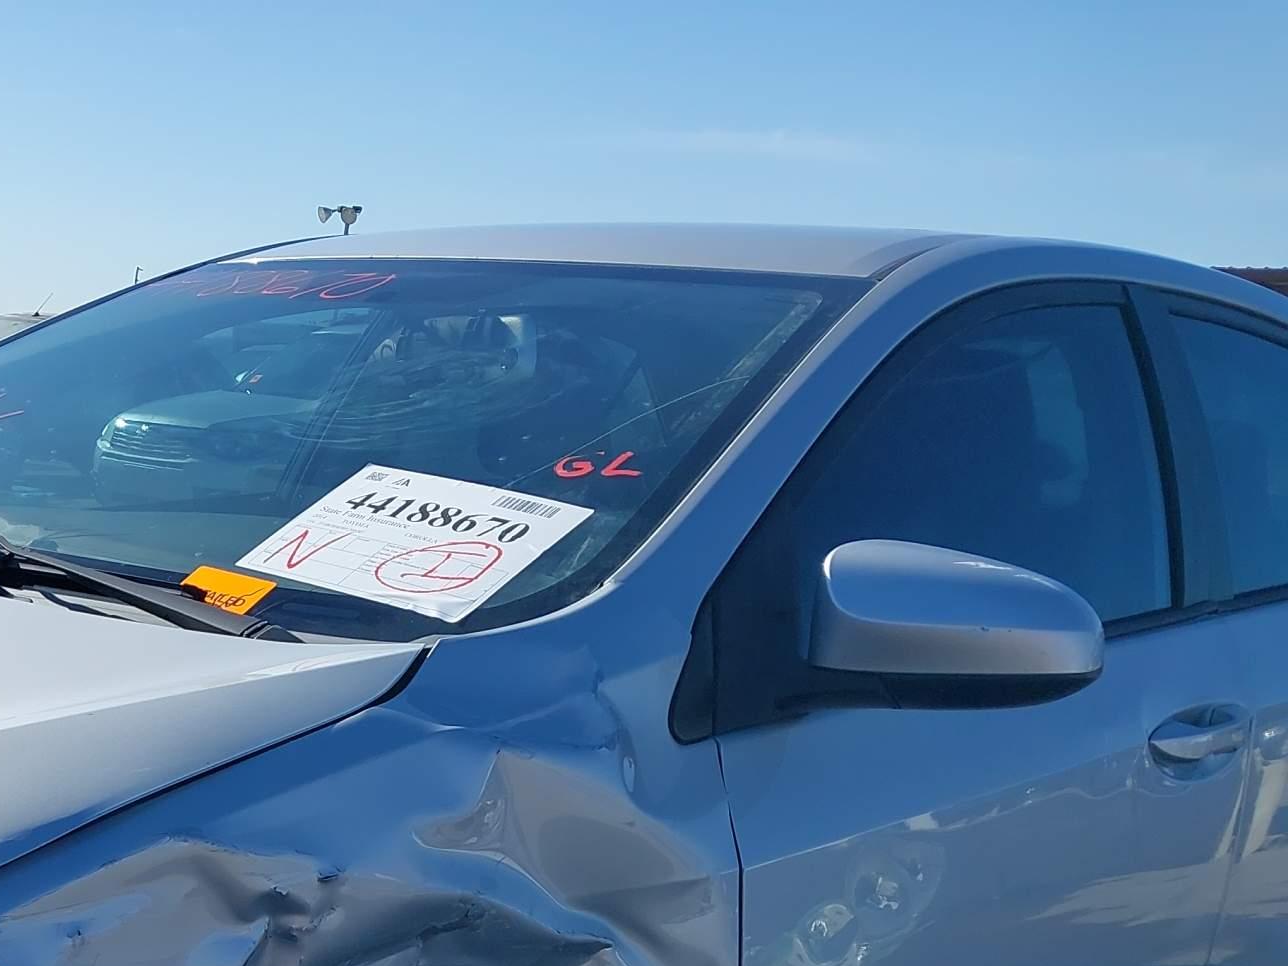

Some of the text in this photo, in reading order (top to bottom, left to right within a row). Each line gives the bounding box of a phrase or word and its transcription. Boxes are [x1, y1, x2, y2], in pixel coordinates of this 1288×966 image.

[320, 506, 342, 516] State
[342, 510, 366, 520] Farm
[367, 513, 410, 529] Insurance
[346, 491, 531, 543] 44188670
[264, 529, 352, 569] N
